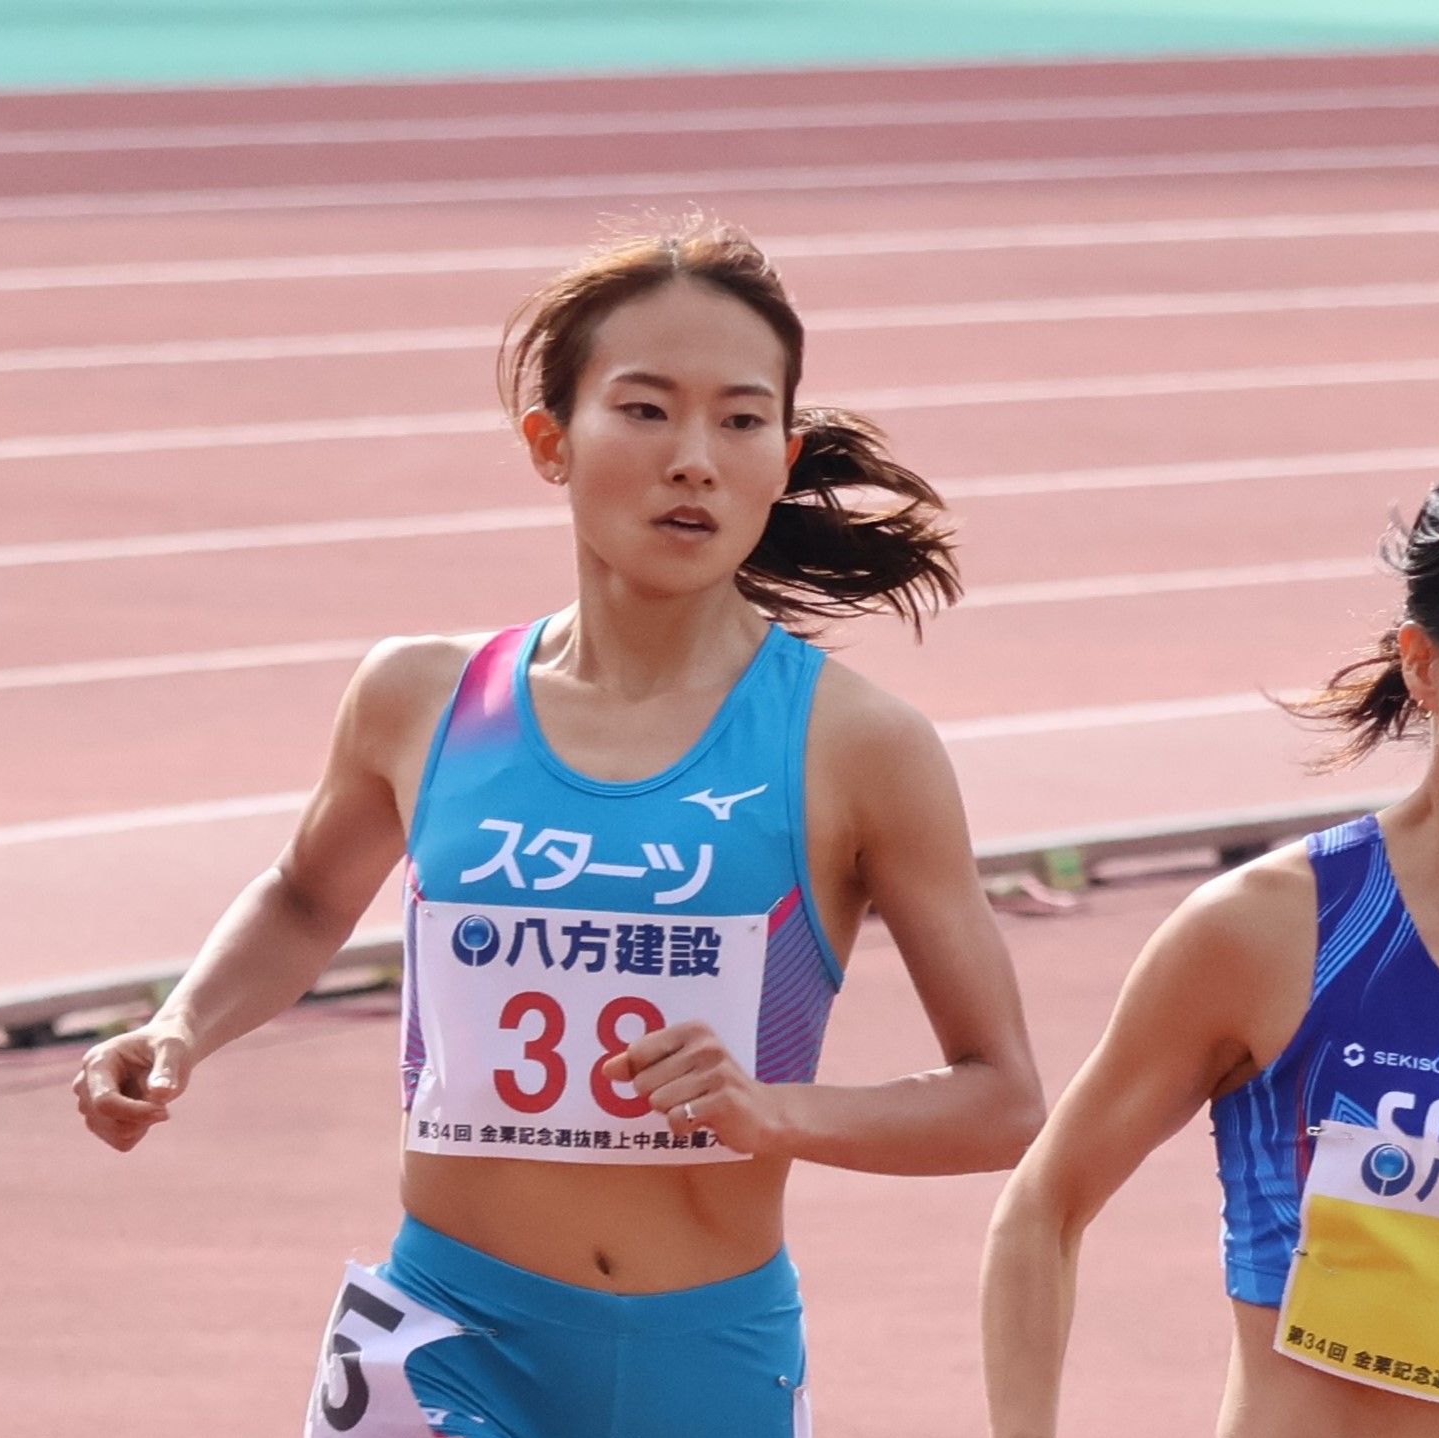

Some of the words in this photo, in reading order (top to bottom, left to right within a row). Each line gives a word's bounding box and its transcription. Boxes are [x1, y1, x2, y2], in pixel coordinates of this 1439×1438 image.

[460, 818, 714, 905] スターツ
[505, 918, 722, 977] 八方建設
[493, 991, 667, 1119] 38
[418, 1120, 472, 1142] 第34回
[1286, 1324, 1348, 1364] 第34回
